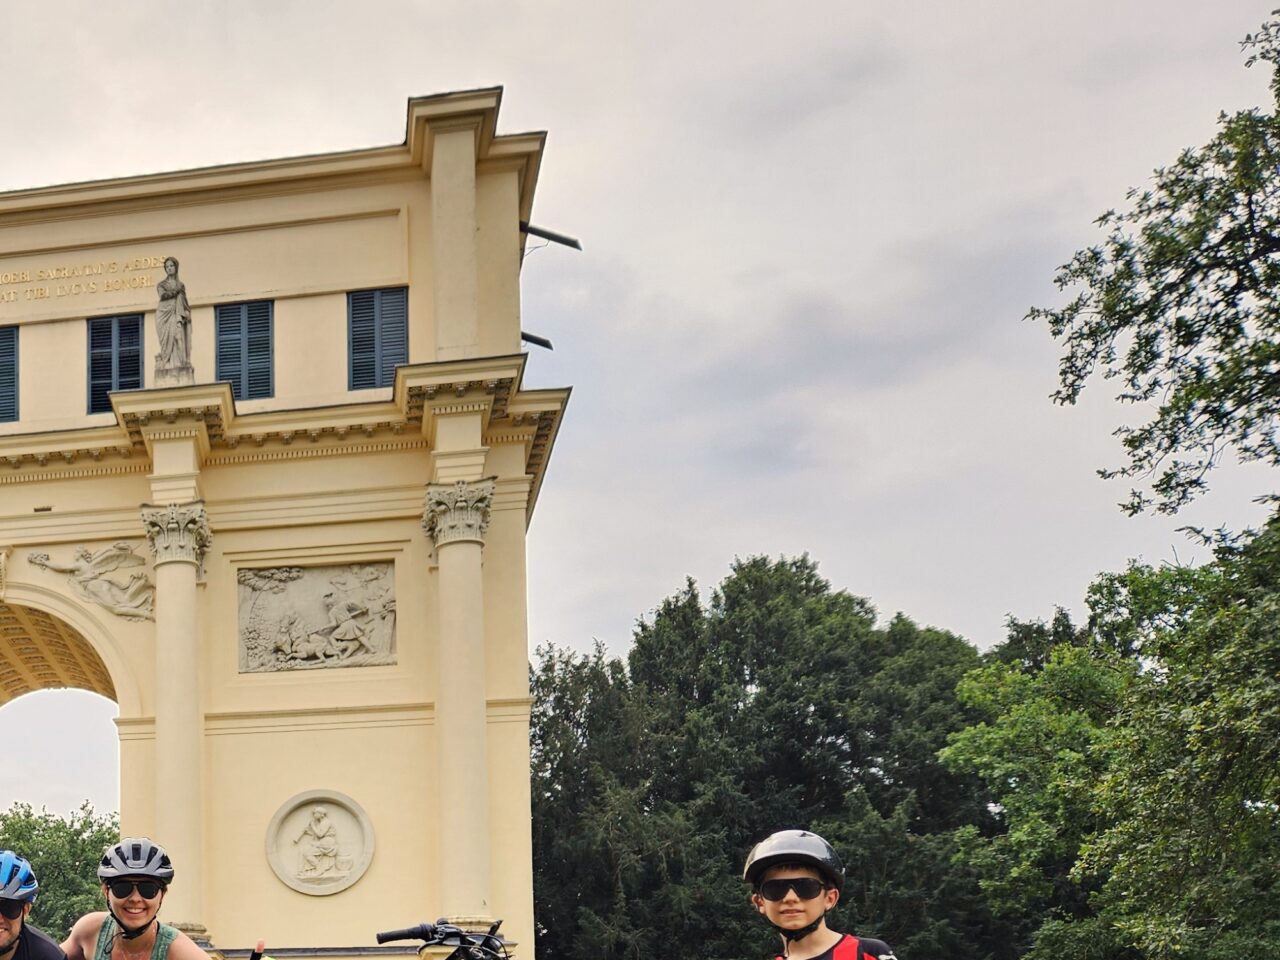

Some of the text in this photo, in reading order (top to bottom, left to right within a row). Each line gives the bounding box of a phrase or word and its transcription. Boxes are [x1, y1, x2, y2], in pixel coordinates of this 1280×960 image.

[25, 287, 50, 300] TIBI
[57, 282, 97, 296] LVCVS
[103, 276, 153, 292] HONORI
